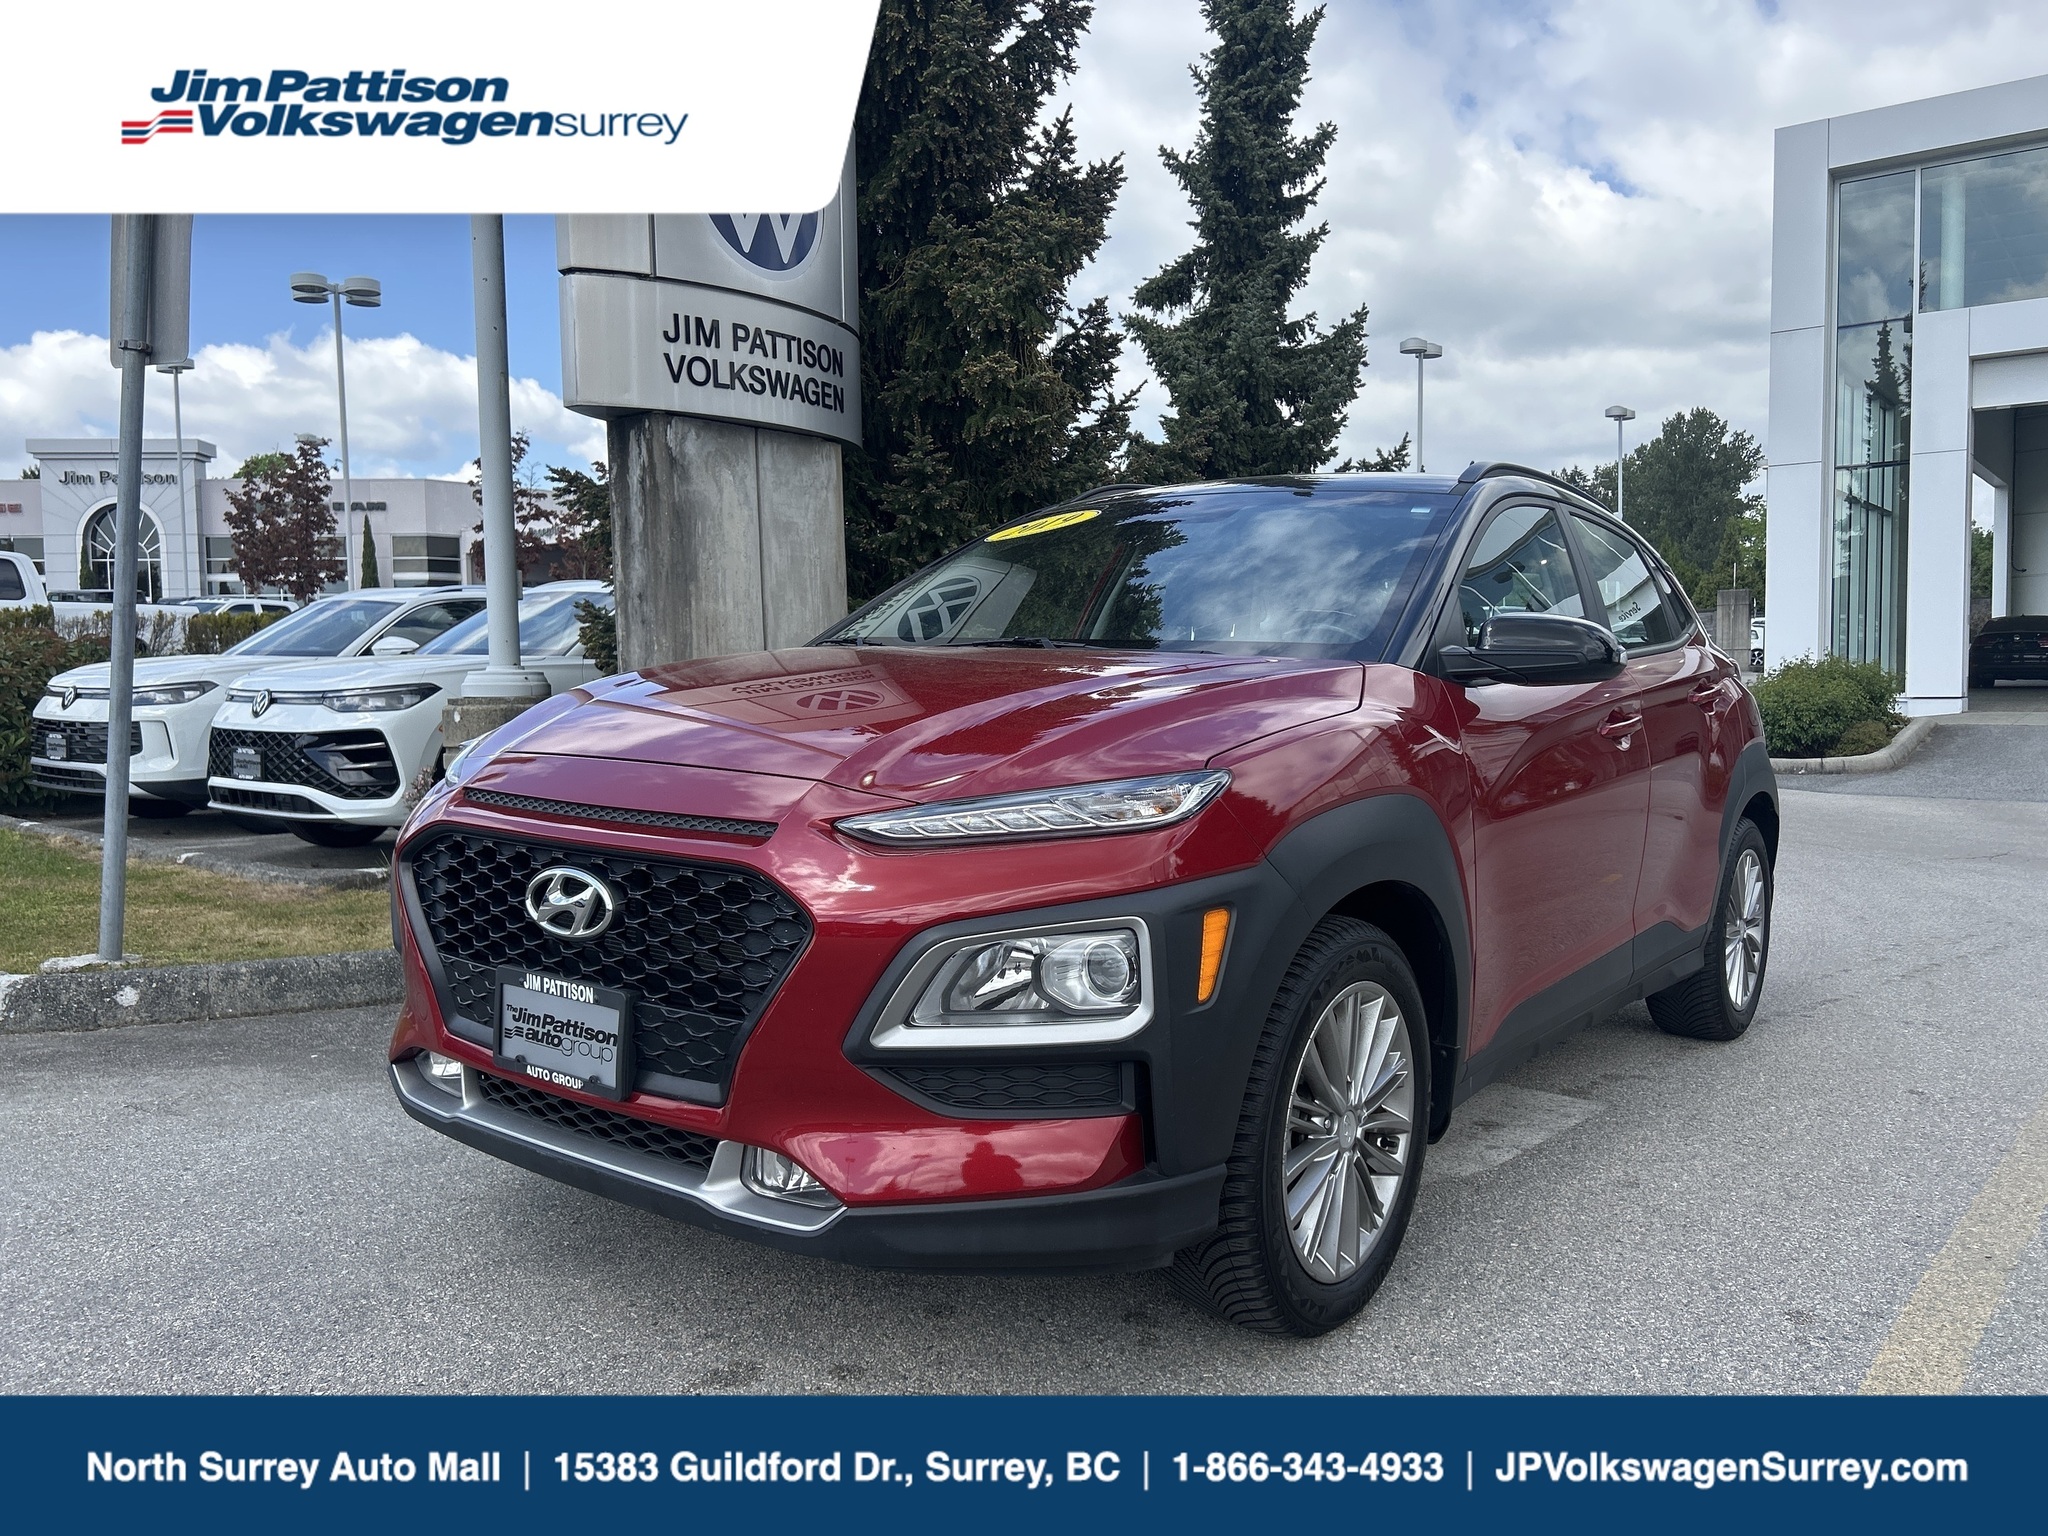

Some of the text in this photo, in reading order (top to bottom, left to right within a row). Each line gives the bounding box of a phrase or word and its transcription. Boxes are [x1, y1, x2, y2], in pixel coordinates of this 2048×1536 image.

[663, 313, 844, 378] JIM PATTISON
[663, 352, 845, 414] VOLKSWAGEN
[59, 470, 94, 485] Jim
[523, 973, 595, 1004] JIM PATTISON
[526, 1064, 584, 1090] AUTO GROUP
